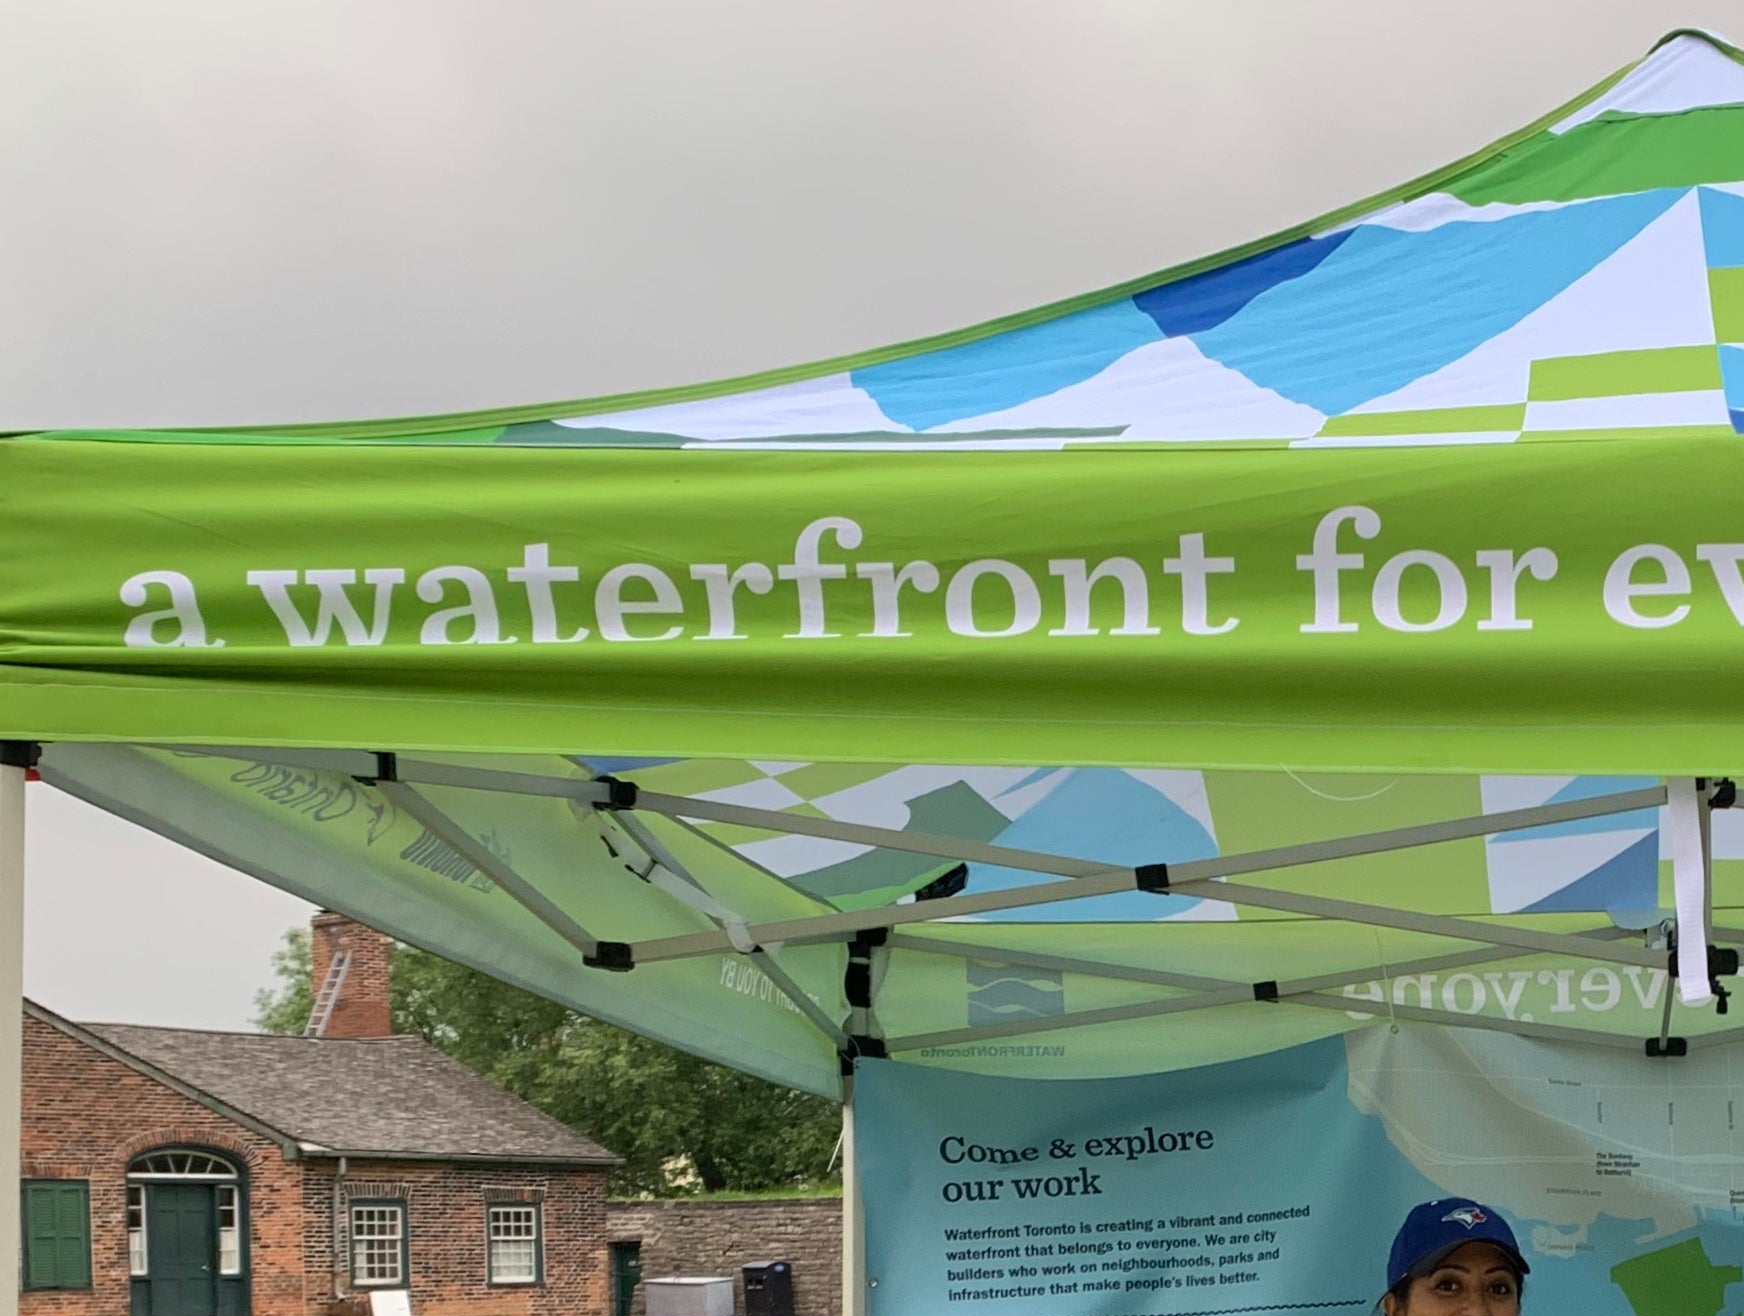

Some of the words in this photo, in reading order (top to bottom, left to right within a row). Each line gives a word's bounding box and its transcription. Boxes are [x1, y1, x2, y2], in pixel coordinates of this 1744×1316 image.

[120, 568, 228, 647] a
[247, 518, 1237, 648] waterfront
[1297, 507, 1558, 635] for
[940, 1136, 1039, 1163] Come
[1049, 1138, 1076, 1159] &
[1084, 1127, 1214, 1160] explore
[942, 1179, 1003, 1202] our
[1011, 1168, 1102, 1199] work
[944, 1225, 1020, 1241] Waterfront
[1023, 1222, 1076, 1237] Toronto
[1079, 1221, 1092, 1234] is
[1095, 1218, 1154, 1235] creating
[1157, 1220, 1166, 1229] a
[1168, 1214, 1215, 1228] vibrant
[1219, 1212, 1243, 1225] and
[1246, 1205, 1310, 1223] connected
[946, 1246, 1020, 1261] waterfront
[1024, 1243, 1054, 1257] that
[1058, 1240, 1114, 1257] belongs
[1117, 1239, 1131, 1251] to
[1135, 1236, 1201, 1252] everyone.
[1204, 1233, 1225, 1246] We
[1229, 1233, 1251, 1244] are
[1253, 1230, 1277, 1244] city
[947, 1266, 1005, 1281] builders
[1008, 1264, 1038, 1277] who
[1041, 1262, 1076, 1275] work
[1080, 1263, 1098, 1273] on
[1101, 1254, 1215, 1273] neighbourhoods,
[1218, 1252, 1254, 1268] parks
[1257, 1249, 1280, 1261] and
[948, 1285, 1046, 1301] infrastructure
[1049, 1282, 1078, 1295] that
[1082, 1279, 1121, 1292] make
[1125, 1275, 1182, 1292] people's
[1185, 1273, 1216, 1287] lives
[1219, 1271, 1260, 1286] better.
